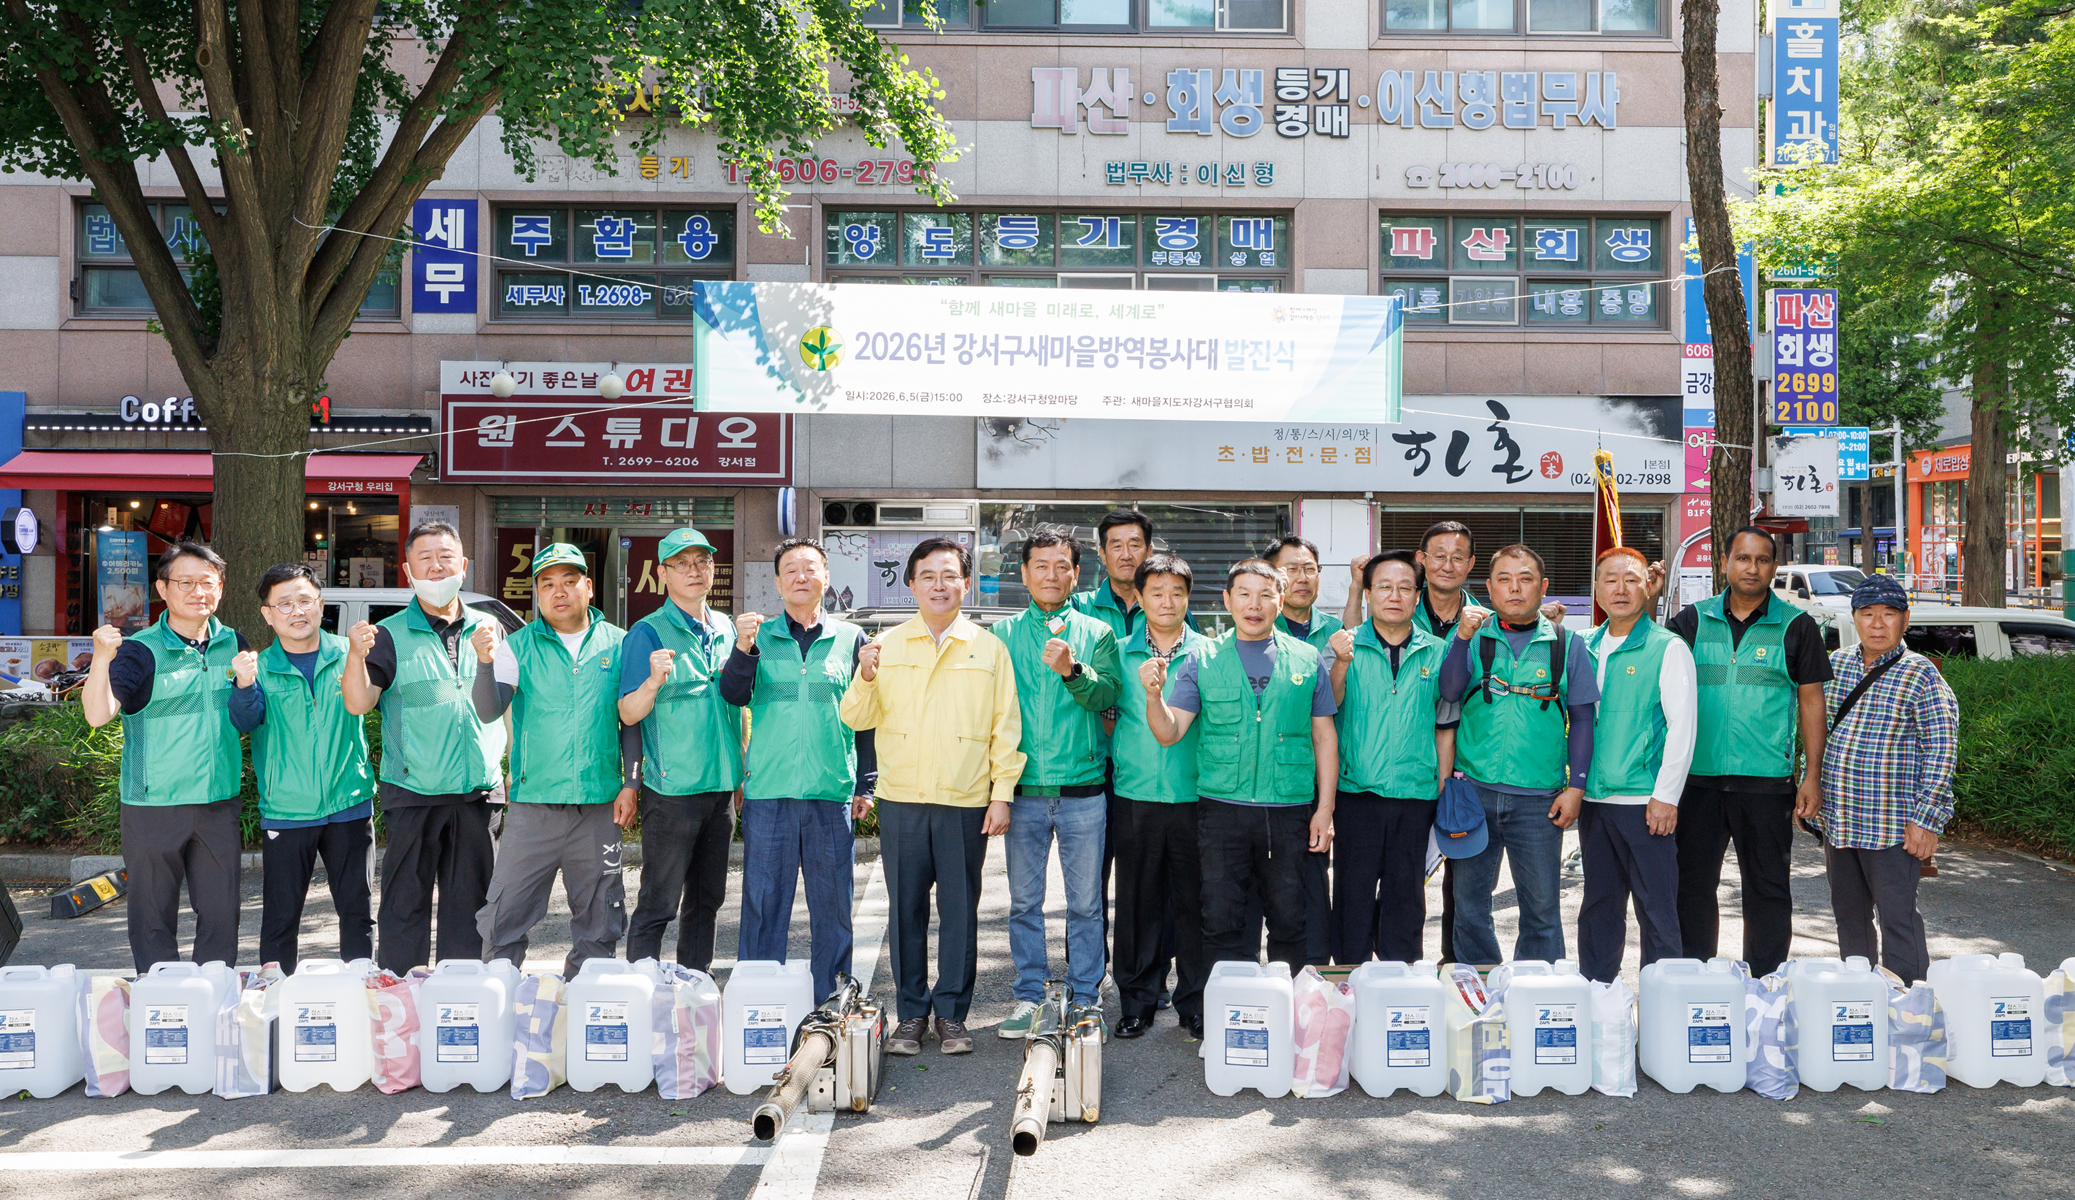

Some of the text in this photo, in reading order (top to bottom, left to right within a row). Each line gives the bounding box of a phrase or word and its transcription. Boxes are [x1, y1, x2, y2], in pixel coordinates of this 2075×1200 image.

[1275, 67, 1350, 102] 등기
[1377, 69, 1620, 130] 이신형법무사
[1274, 104, 1350, 138] 경매
[1438, 162, 1579, 189] 2699-2100
[1151, 251, 1201, 267] 부동산
[506, 285, 566, 306] 세무사
[989, 301, 1038, 318] 새마을
[1047, 302, 1099, 319] 미래로,
[1776, 293, 1836, 330] 파산
[854, 331, 1296, 373] 2026년 강서구새마을방역봉사대 발진식
[1777, 333, 1835, 368] 회생
[120, 395, 201, 423] Coff
[982, 393, 1078, 406] 장소:강서구청앞마당
[1102, 395, 1126, 407] 주관:
[1131, 396, 1254, 409] 새마을지도자강서구협의회
[619, 456, 699, 467] 2699-6206
[718, 457, 757, 468] 강서점
[328, 481, 393, 492] 강서구청 우리집
[1687, 509, 1705, 517] B1F
